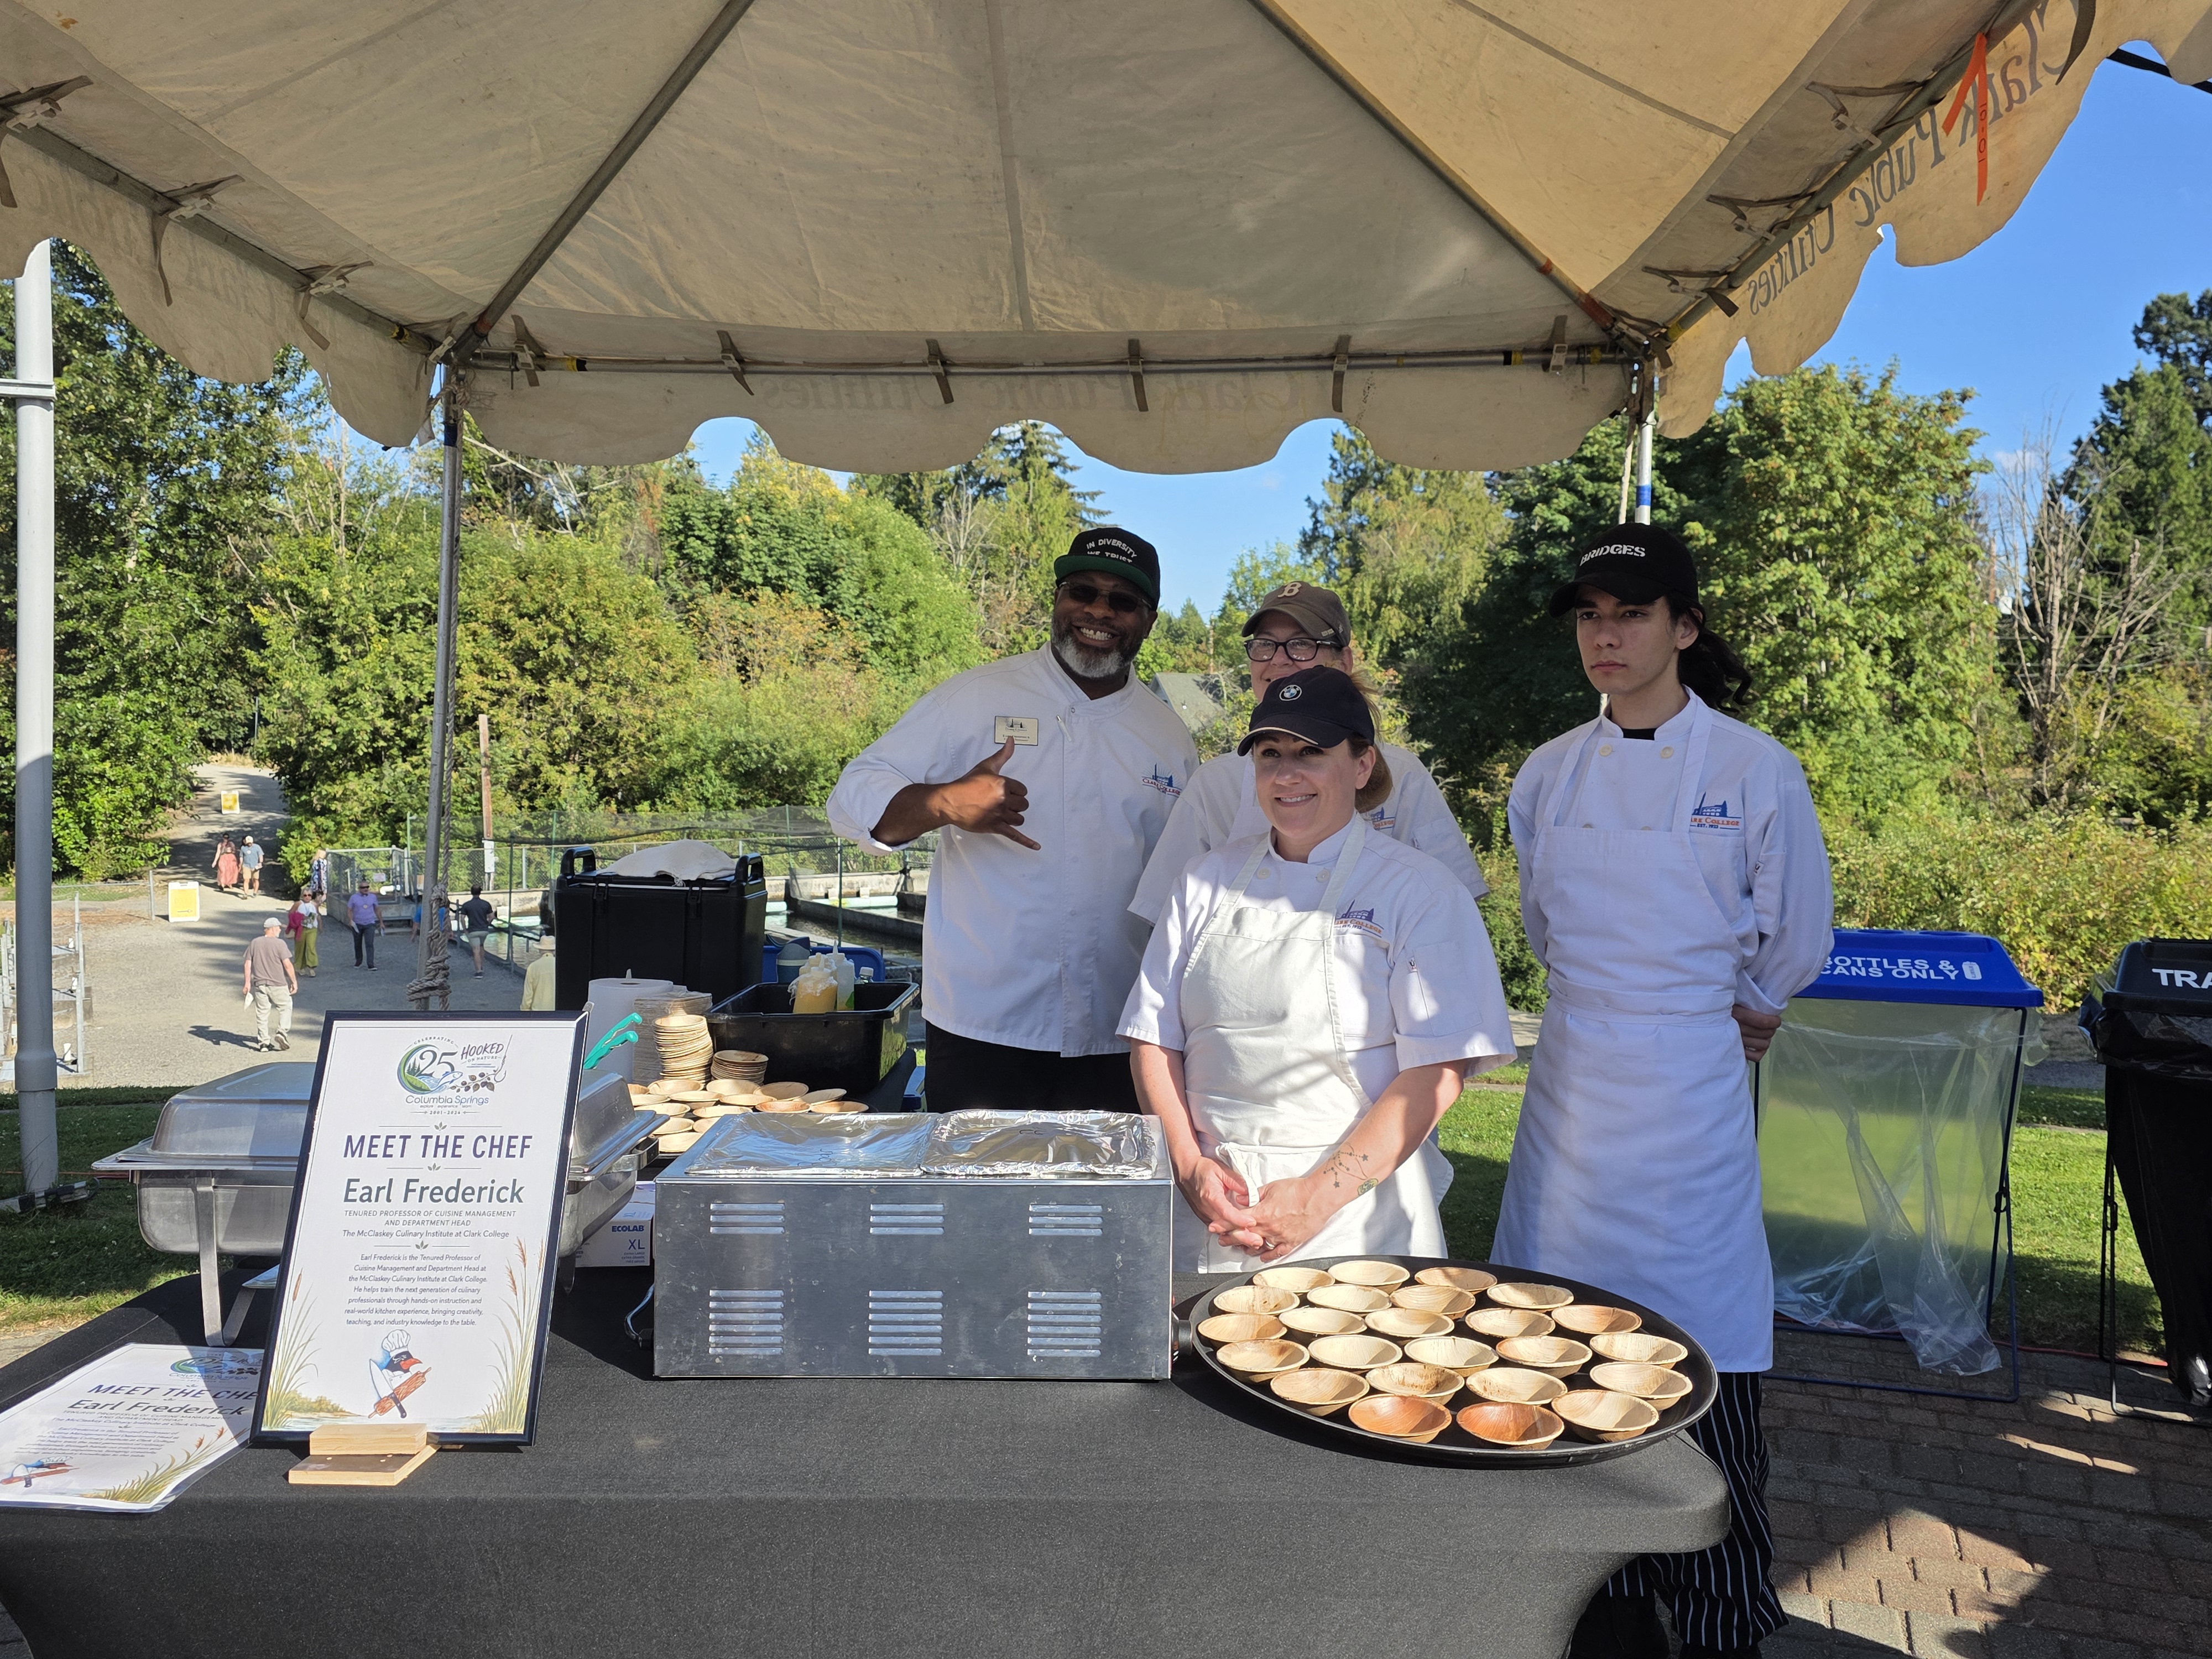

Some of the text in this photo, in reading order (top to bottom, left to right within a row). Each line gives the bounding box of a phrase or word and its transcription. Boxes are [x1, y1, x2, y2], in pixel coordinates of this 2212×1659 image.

[1086, 538, 1138, 557] IN DIVERSITY
[1579, 544, 1646, 567] BRIDGES
[1277, 582, 1302, 597] B
[1820, 965, 1883, 977] CANS
[1891, 968, 1959, 980] ONLY
[1938, 960, 1955, 970] &
[414, 1036, 454, 1045] CELEBRATING
[461, 1042, 504, 1060] HOOKED
[415, 1050, 458, 1077] 25
[405, 1095, 489, 1106] Columbia Springs
[343, 1135, 533, 1159] MEET THE CHEF
[343, 1178, 525, 1203] Earl Frederick
[357, 1230, 394, 1239] McClaskey
[396, 1230, 424, 1239] Culinary
[483, 1230, 509, 1239] College
[628, 1239, 645, 1250] XL
[377, 1265, 414, 1273] Management
[428, 1265, 462, 1273] Department
[363, 1286, 379, 1295] helps
[419, 1286, 449, 1295] generation
[458, 1286, 481, 1295] culinary
[398, 1308, 430, 1316] experience,
[431, 1308, 455, 1316] bringing
[456, 1308, 483, 1316] creativity,
[87, 1384, 258, 1400] MEET THE CHE
[67, 1399, 249, 1415] Earl Frederick
